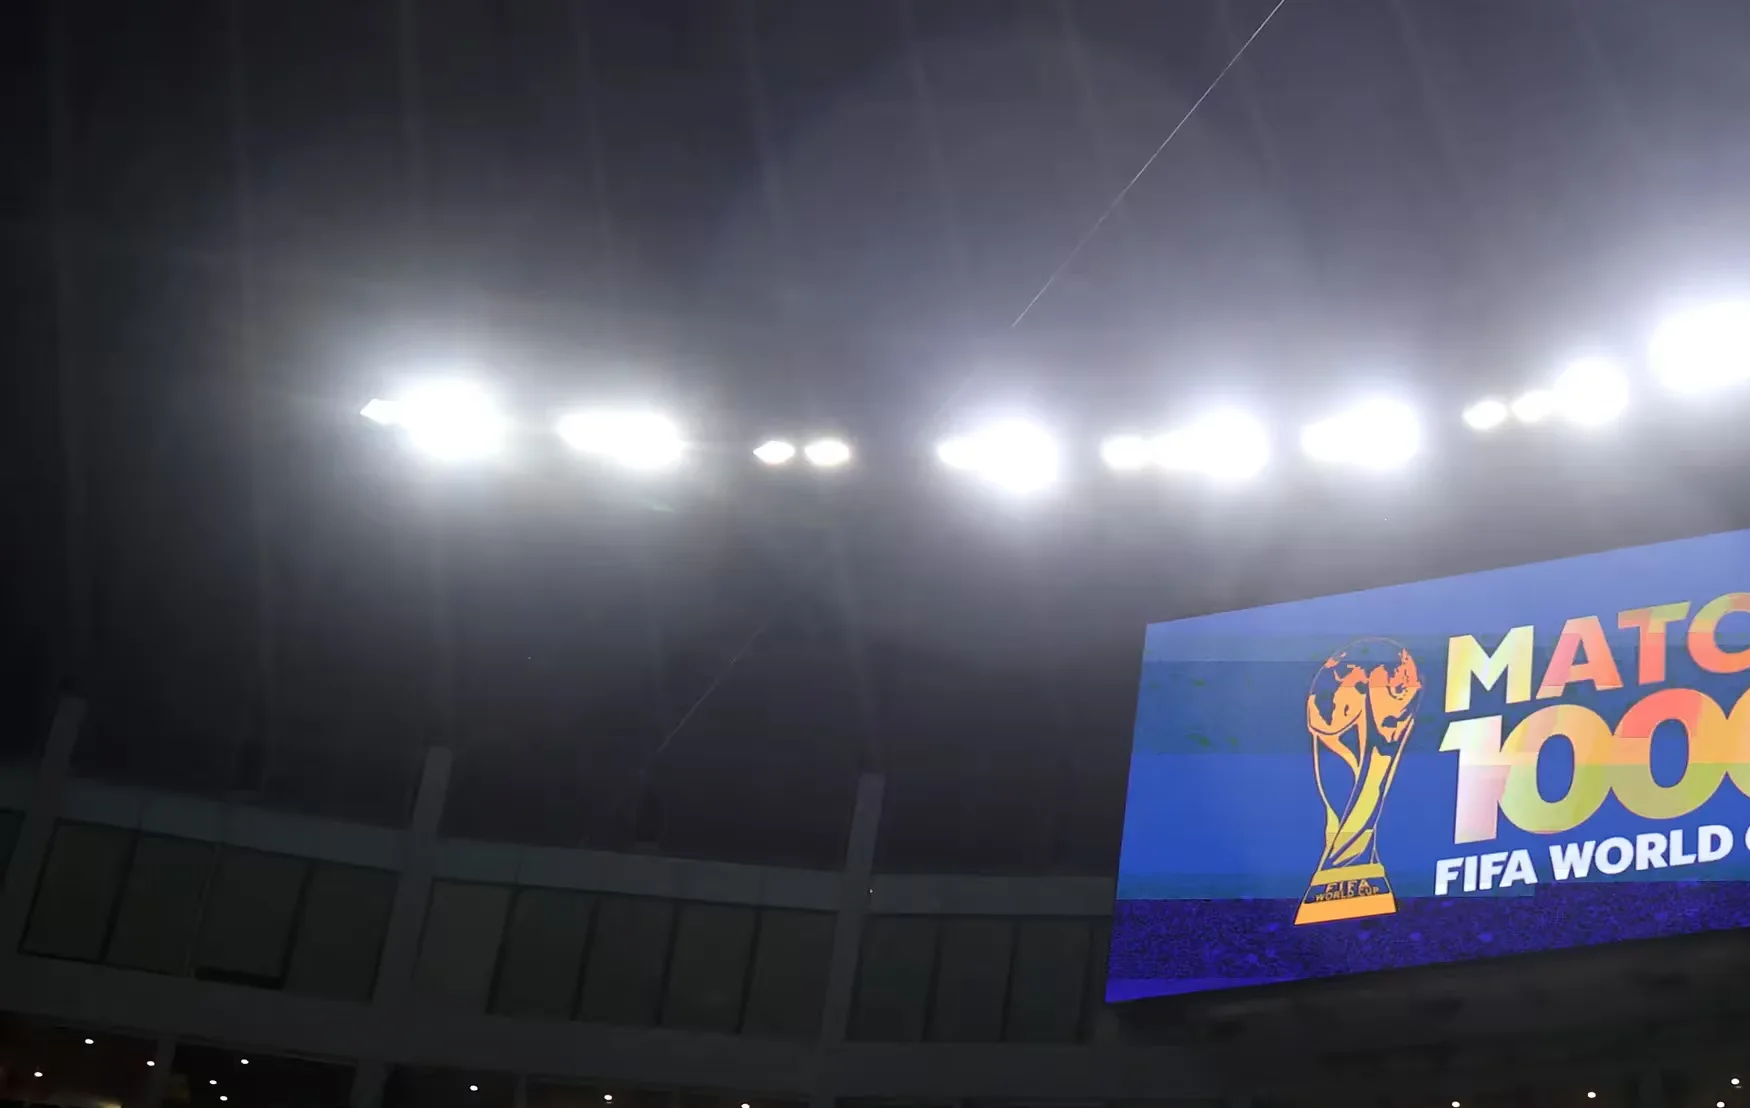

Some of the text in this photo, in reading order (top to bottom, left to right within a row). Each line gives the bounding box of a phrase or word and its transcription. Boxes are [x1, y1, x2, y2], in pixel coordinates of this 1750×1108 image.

[1434, 852, 1538, 896] FIFA
[1550, 824, 1734, 880] WORLD
[1315, 886, 1379, 902] WORLD CUP
[1325, 879, 1370, 893] FIFA
